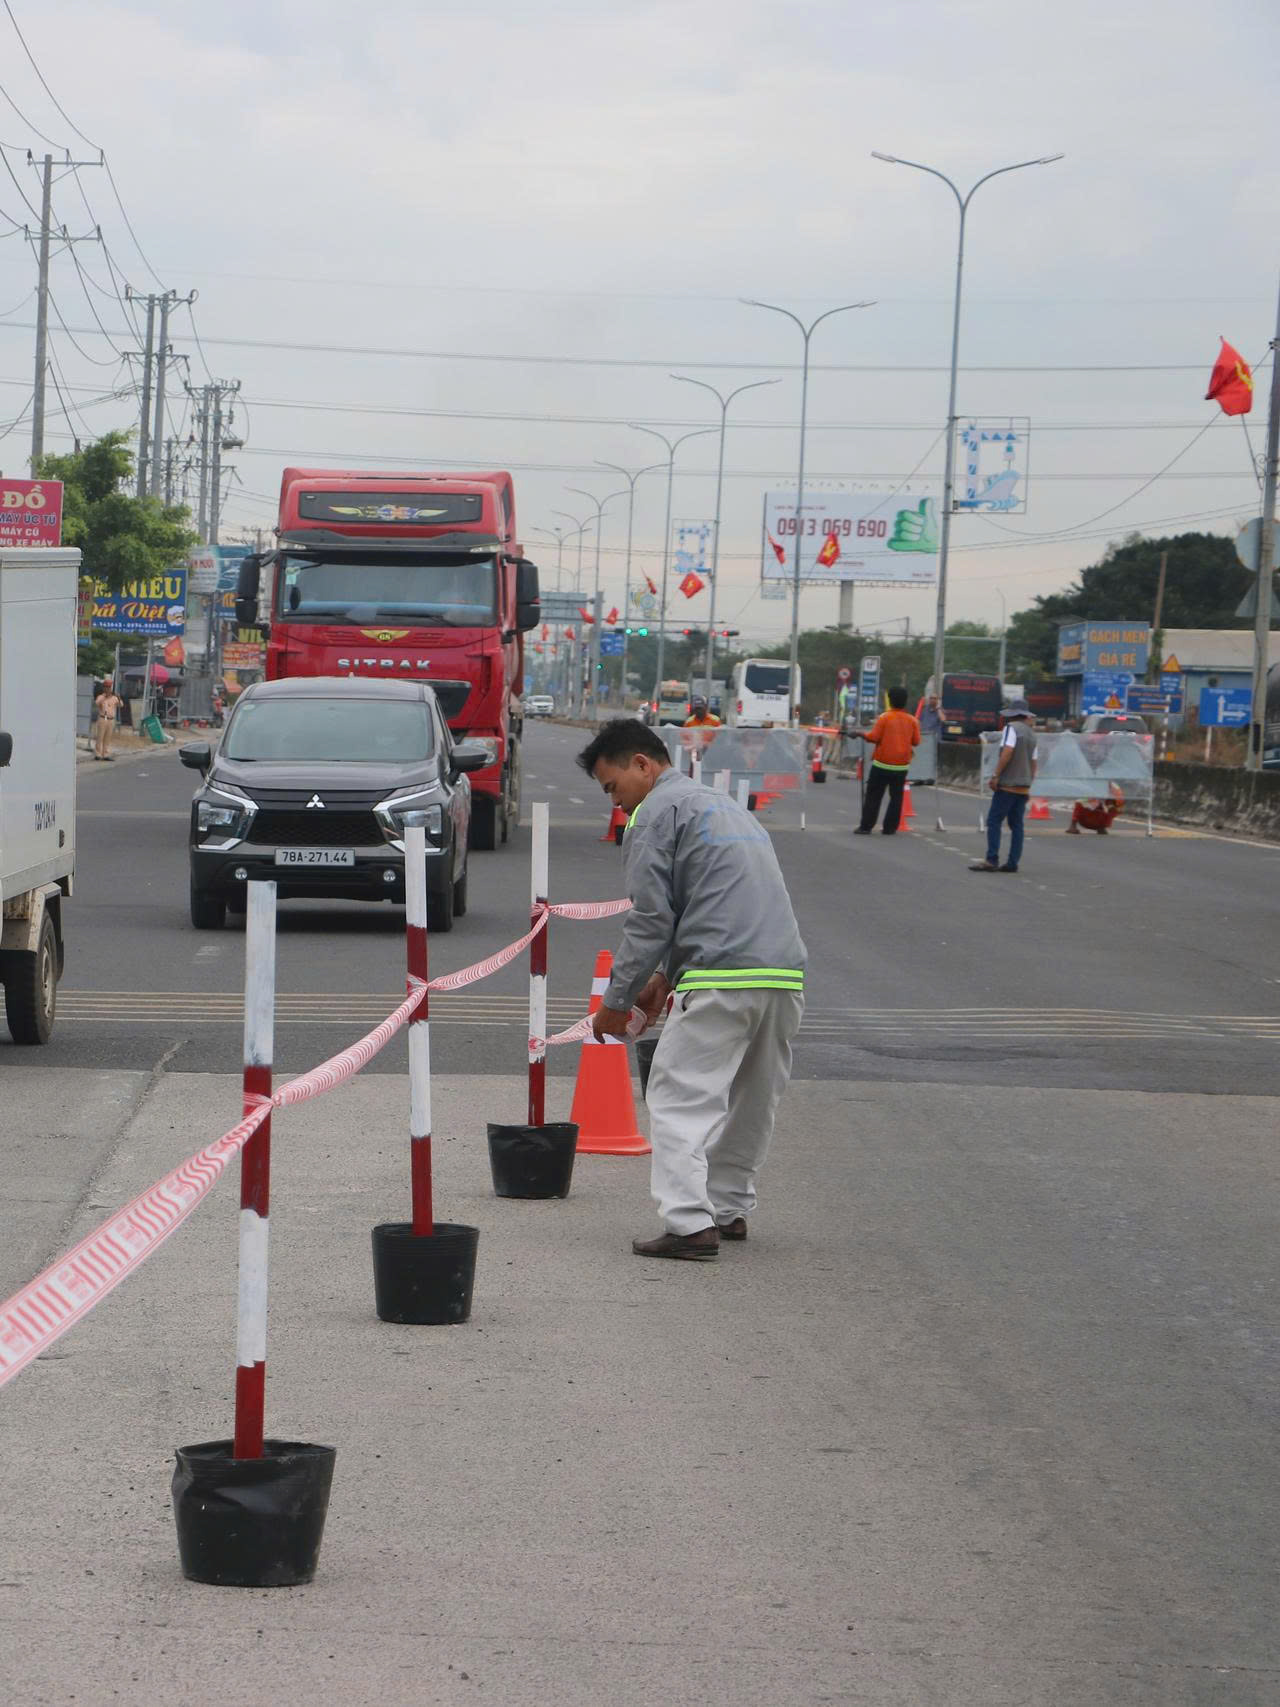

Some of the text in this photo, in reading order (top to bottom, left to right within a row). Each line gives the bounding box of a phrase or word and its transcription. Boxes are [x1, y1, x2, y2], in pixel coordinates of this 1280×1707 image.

[2, 484, 46, 509] ĐỒ
[1, 523, 22, 536] MÁY
[822, 518, 851, 537] 069
[856, 520, 887, 538] 690
[337, 658, 432, 671] SITRAK
[281, 851, 348, 865] 78A-271.44
